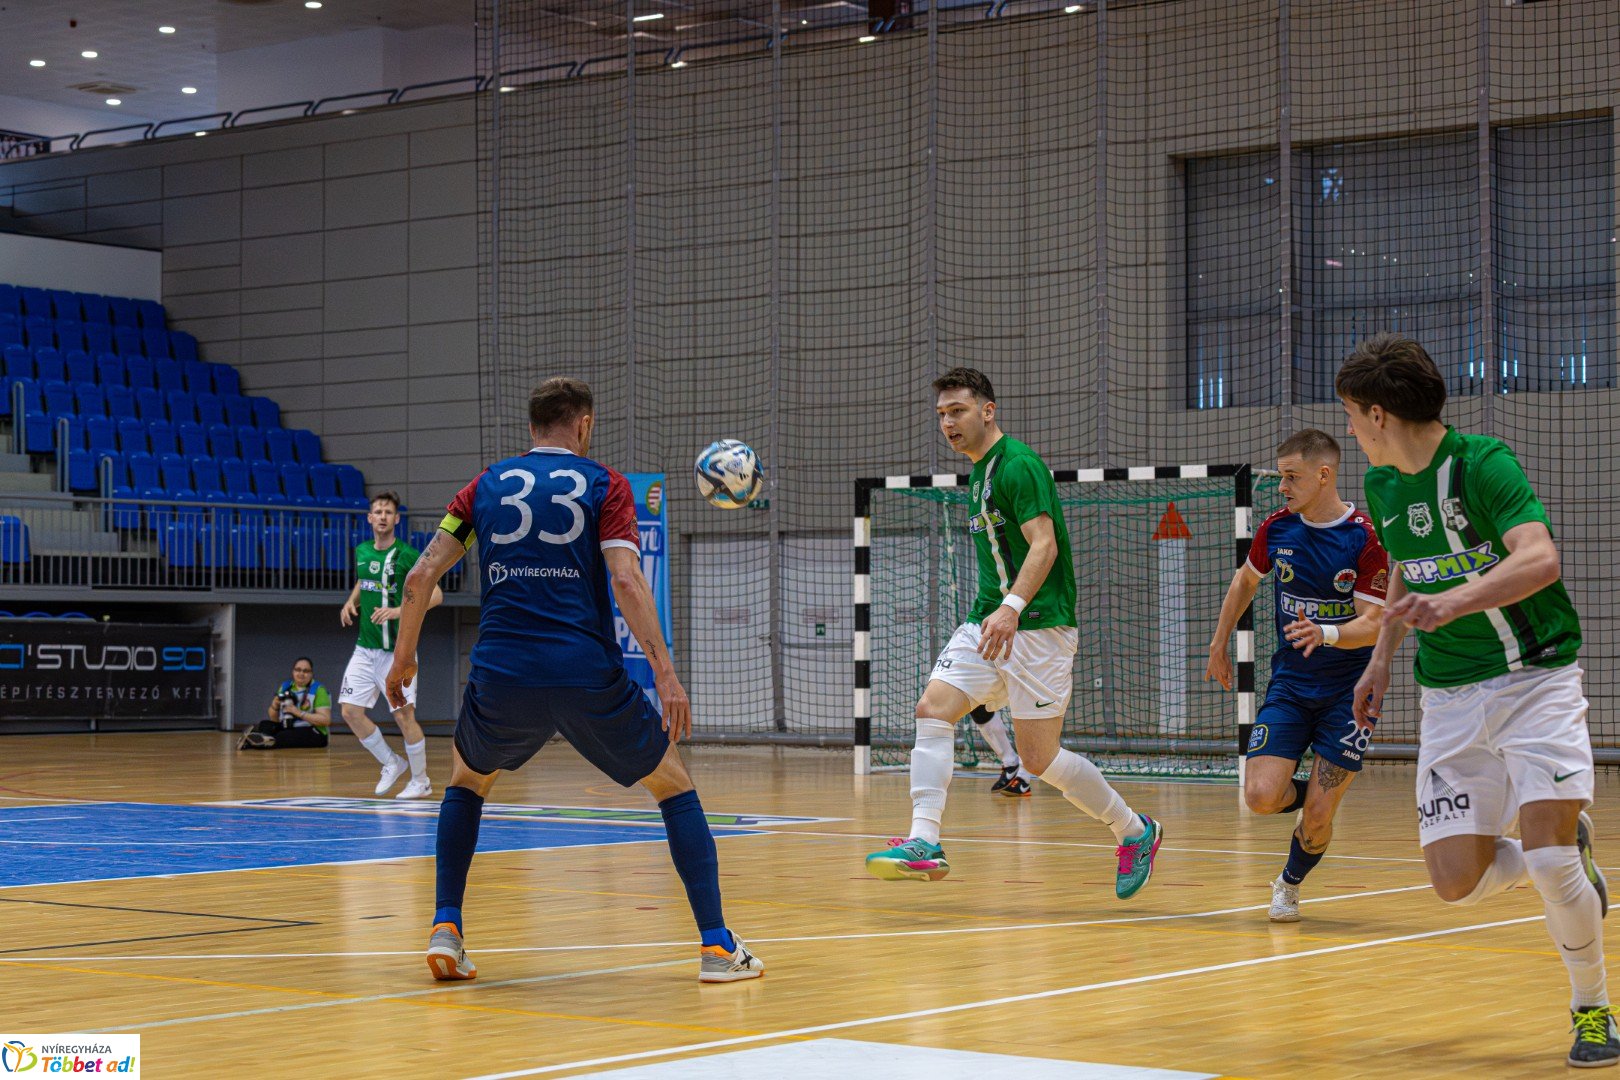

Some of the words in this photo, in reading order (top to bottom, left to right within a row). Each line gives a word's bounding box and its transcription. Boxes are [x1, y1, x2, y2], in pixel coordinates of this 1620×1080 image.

[490, 468, 587, 545] 33
[1276, 547, 1294, 556] JAKO
[510, 566, 580, 578] NYÍREGYHÁZA
[162, 646, 206, 671] 90
[172, 686, 202, 699] KFT
[1339, 720, 1372, 752] 28
[1342, 749, 1361, 761] JAKO
